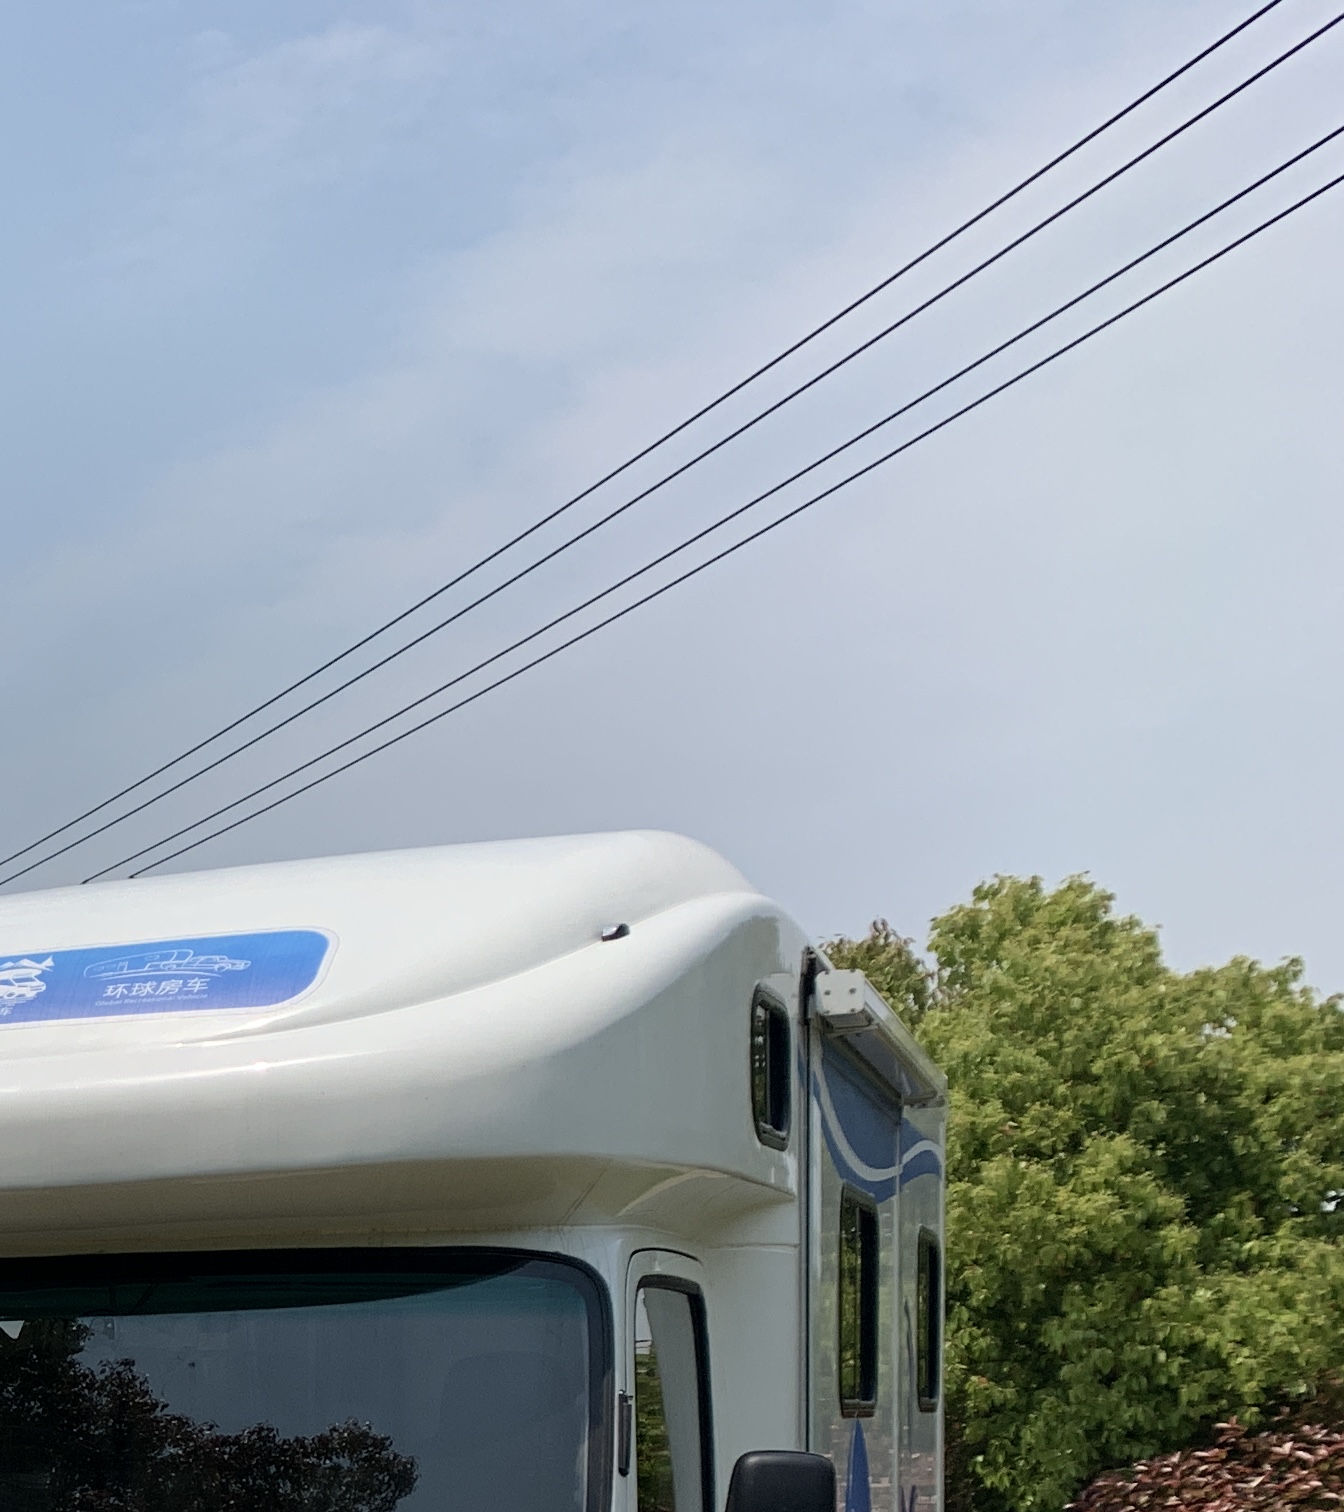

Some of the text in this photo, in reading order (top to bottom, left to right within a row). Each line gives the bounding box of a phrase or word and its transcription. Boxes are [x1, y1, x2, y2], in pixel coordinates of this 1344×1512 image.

[102, 977, 211, 998] 环球房车
[94, 999, 122, 1007] Global
